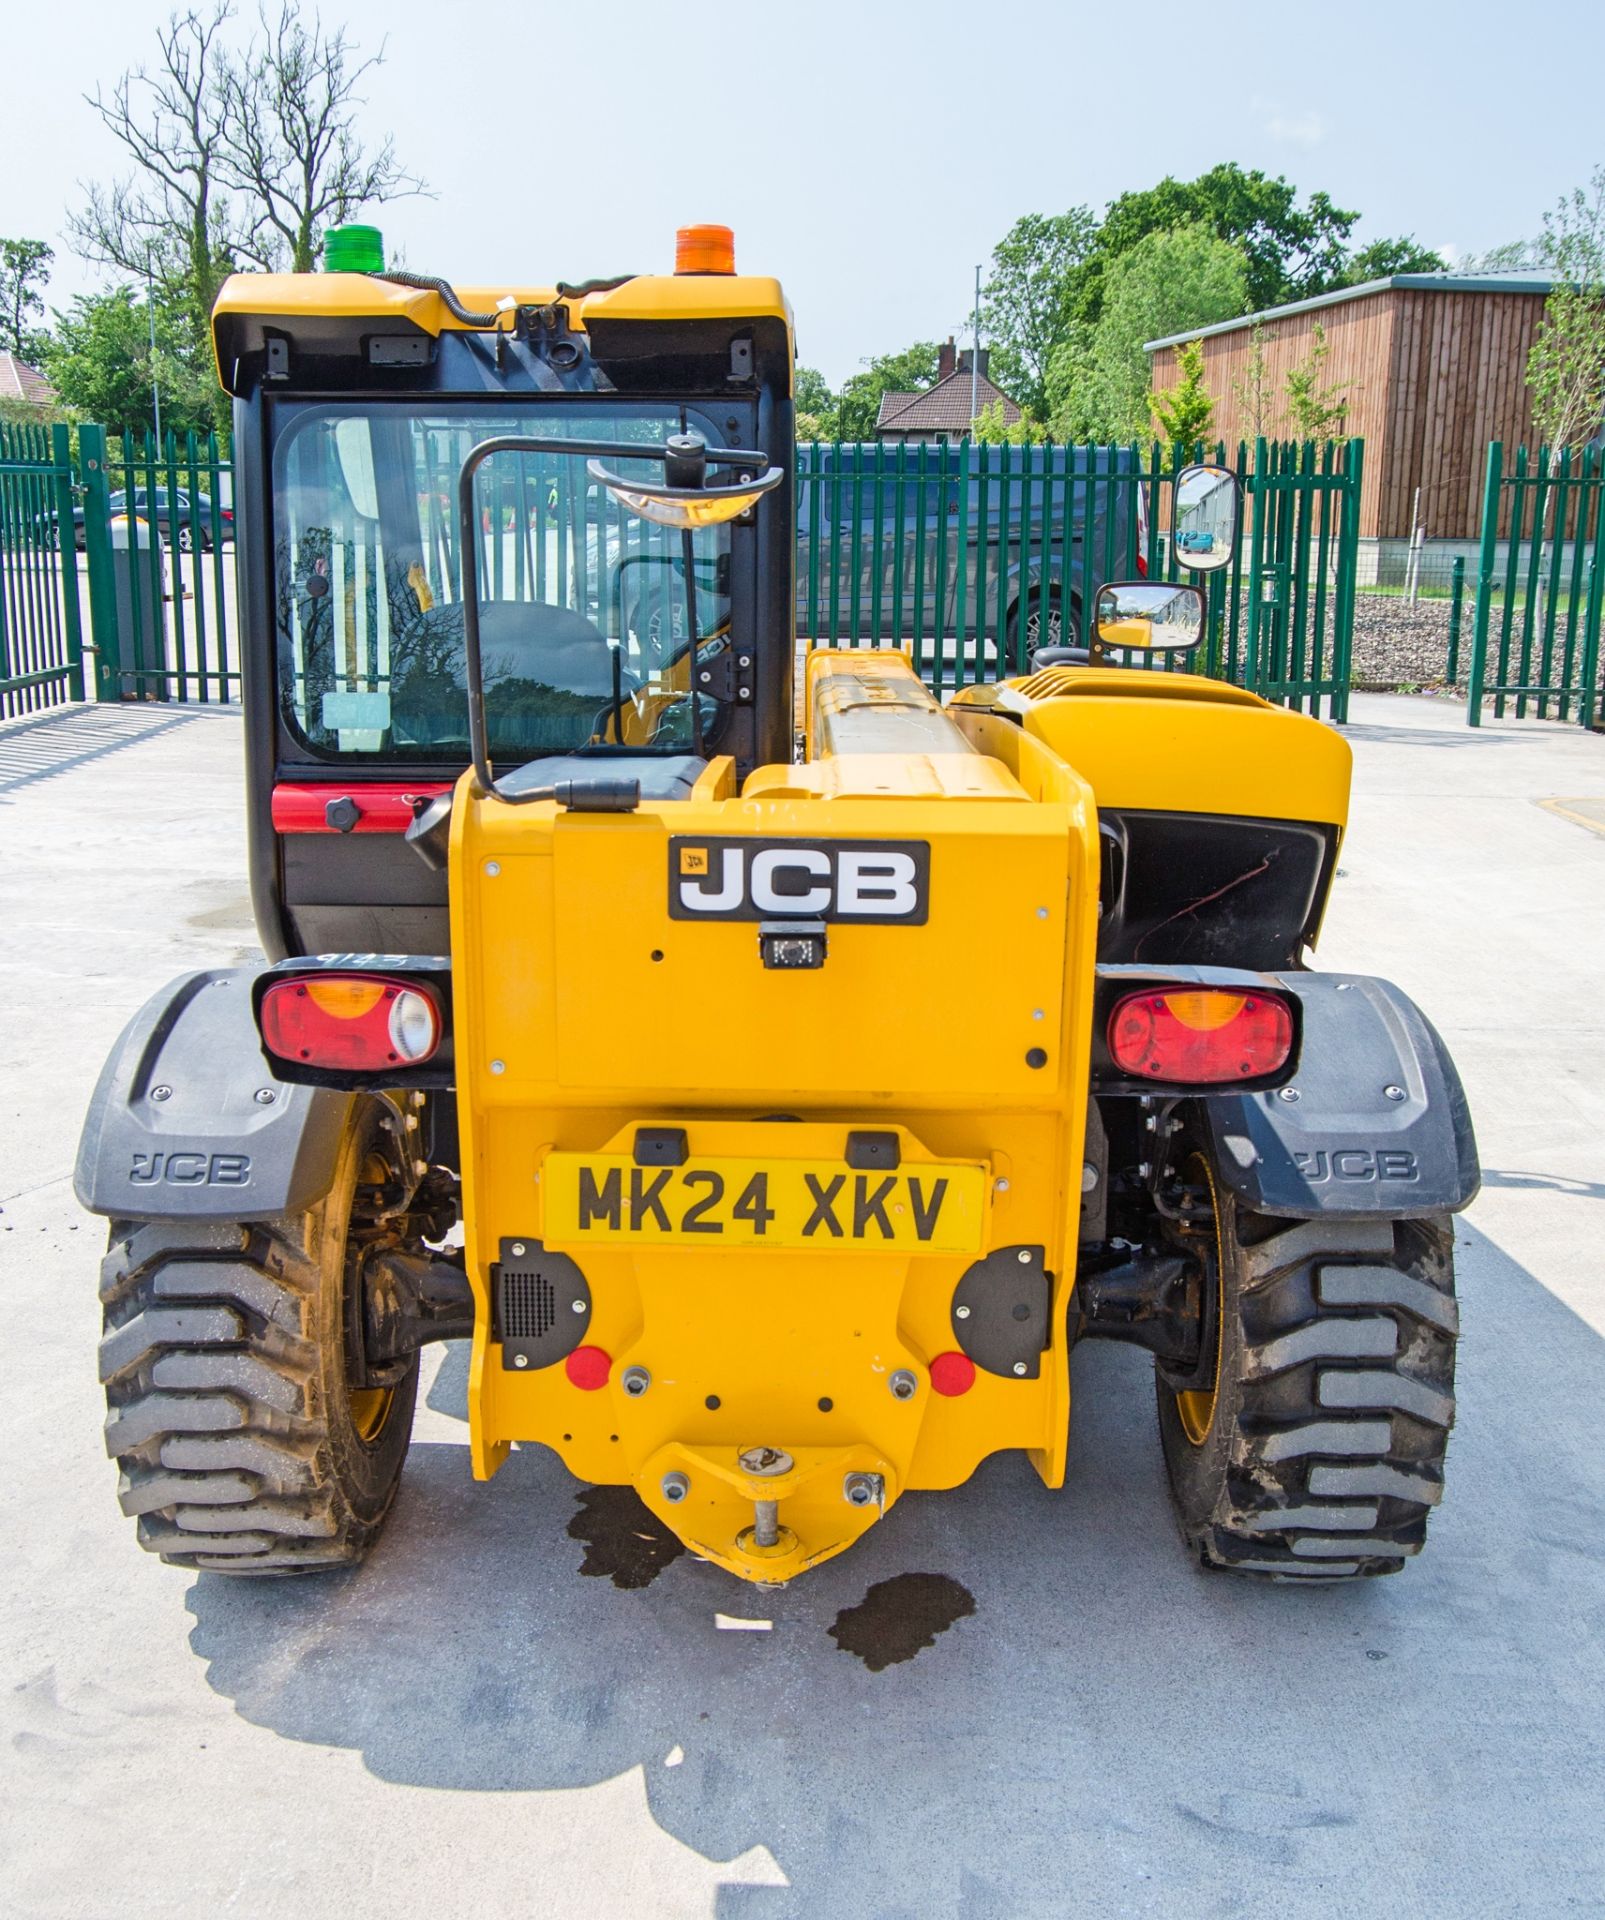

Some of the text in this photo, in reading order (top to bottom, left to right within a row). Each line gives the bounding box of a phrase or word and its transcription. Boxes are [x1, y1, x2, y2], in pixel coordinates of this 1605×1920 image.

[680, 848, 917, 914] JCB
[130, 1153, 251, 1186] JCB
[1294, 1150, 1420, 1184] JCB
[578, 1166, 950, 1241] MK24 XKV
